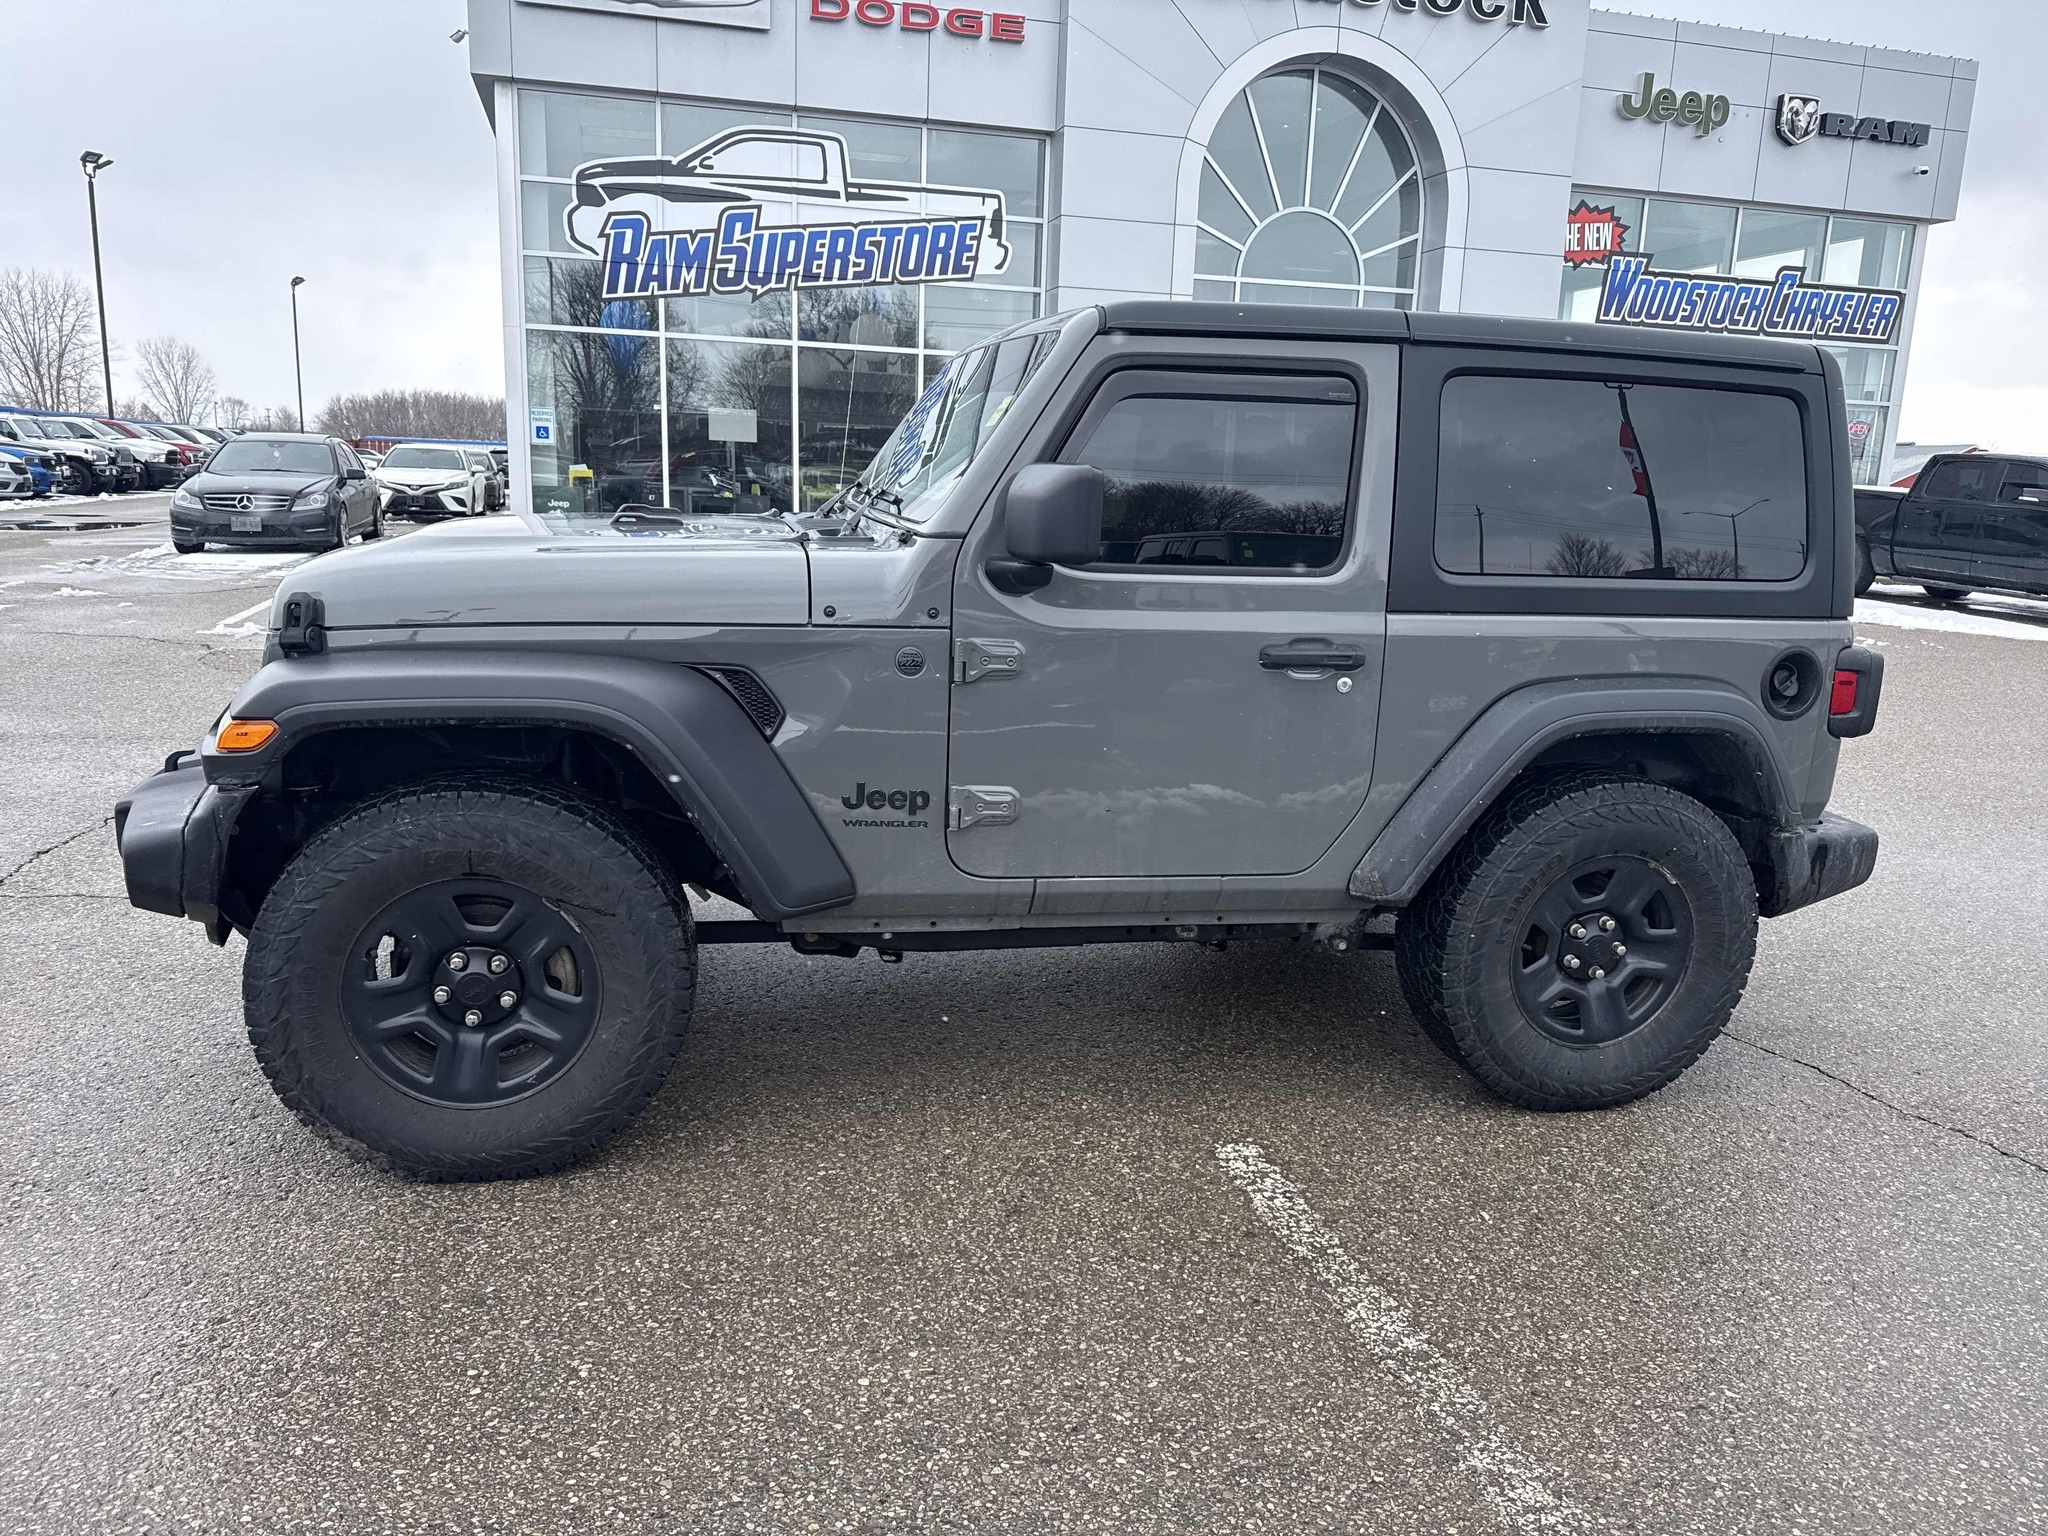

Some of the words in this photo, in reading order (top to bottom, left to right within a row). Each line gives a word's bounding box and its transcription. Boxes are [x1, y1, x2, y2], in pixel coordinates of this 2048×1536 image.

[811, 0, 1026, 41] DODGE
[1617, 72, 1730, 137] Jeep
[1820, 112, 1932, 147] RAM
[603, 213, 714, 298] RAM
[713, 208, 982, 294] SUPERSTORE
[1565, 222, 1582, 252] HE
[1584, 222, 1614, 251] NEW
[1600, 255, 1772, 329] WOODSTOCK
[1764, 270, 1901, 340] CHRYSLER
[1848, 422, 1870, 435] OPEN
[547, 498, 570, 509] Jeep
[842, 781, 930, 816] Jeep
[842, 819, 929, 828] WRANGLER
